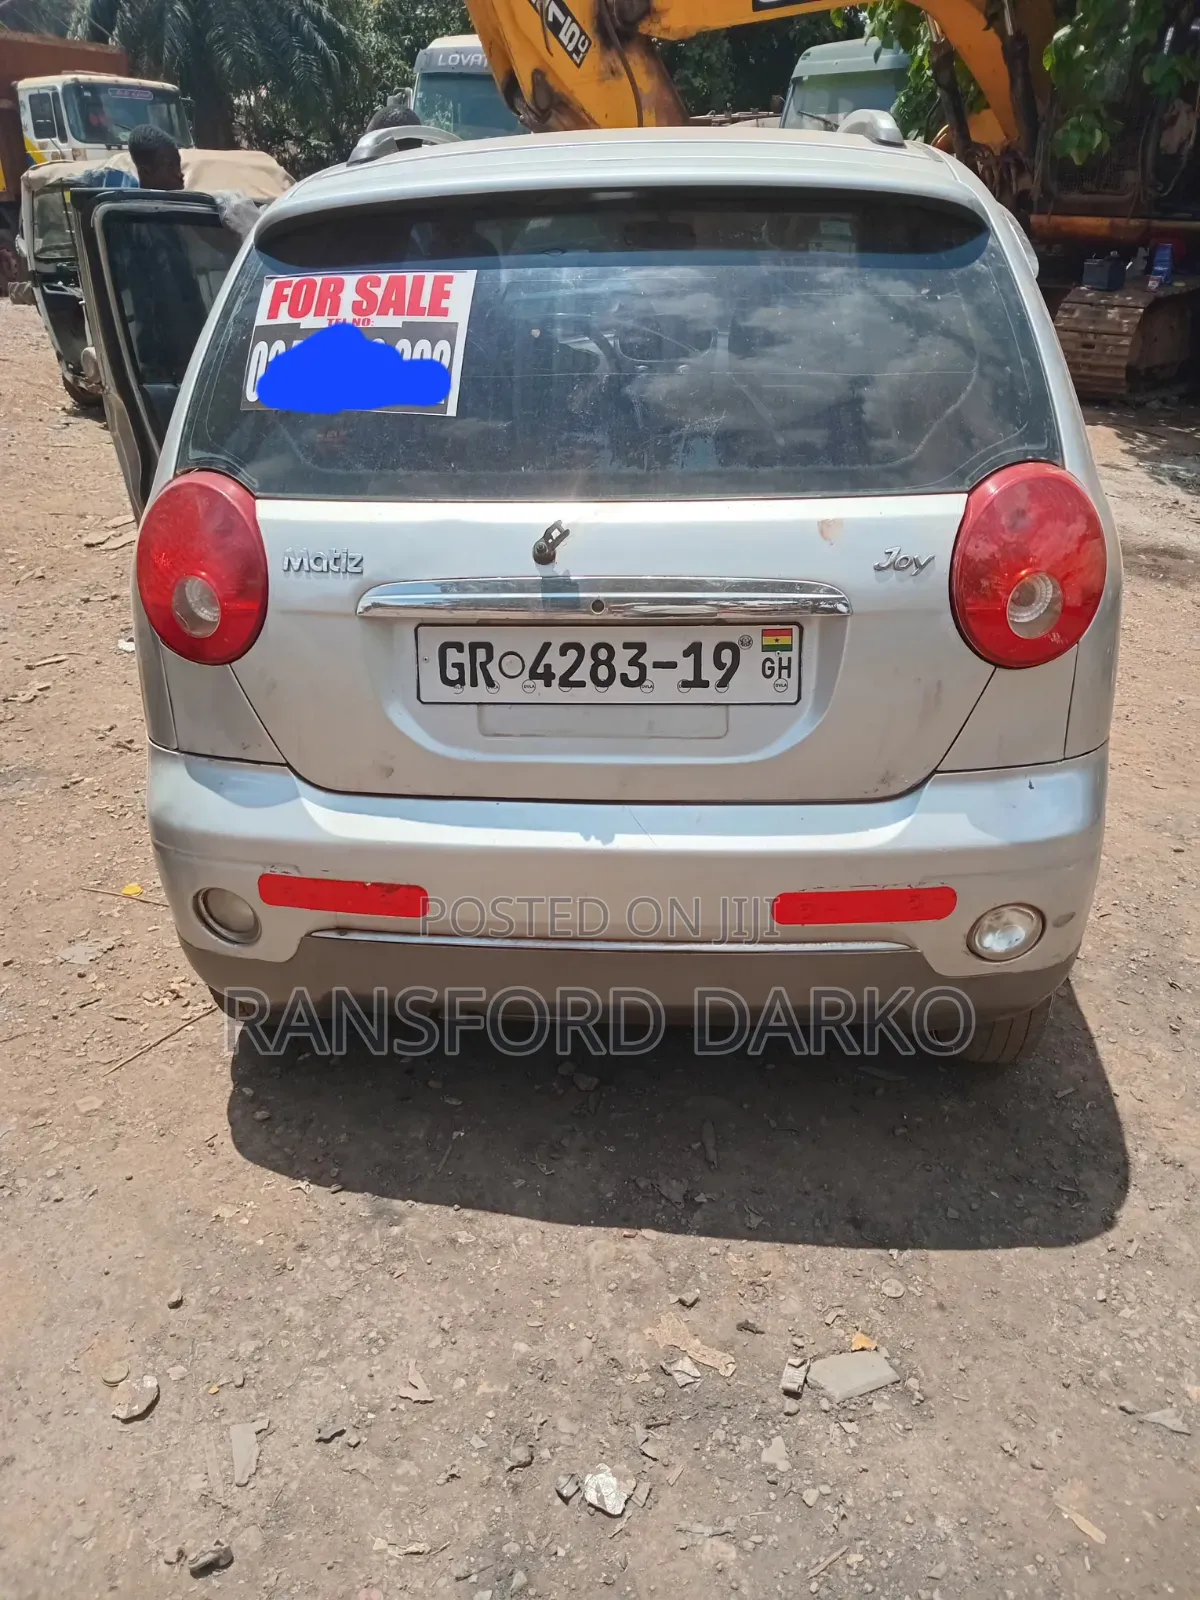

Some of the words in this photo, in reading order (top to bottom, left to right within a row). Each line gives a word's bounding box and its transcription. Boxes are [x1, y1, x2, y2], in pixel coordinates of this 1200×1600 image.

[266, 276, 346, 320] FOR
[351, 274, 454, 318] SALE
[282, 547, 364, 574] Matiz
[873, 546, 936, 577] Joy
[761, 656, 793, 680] GH
